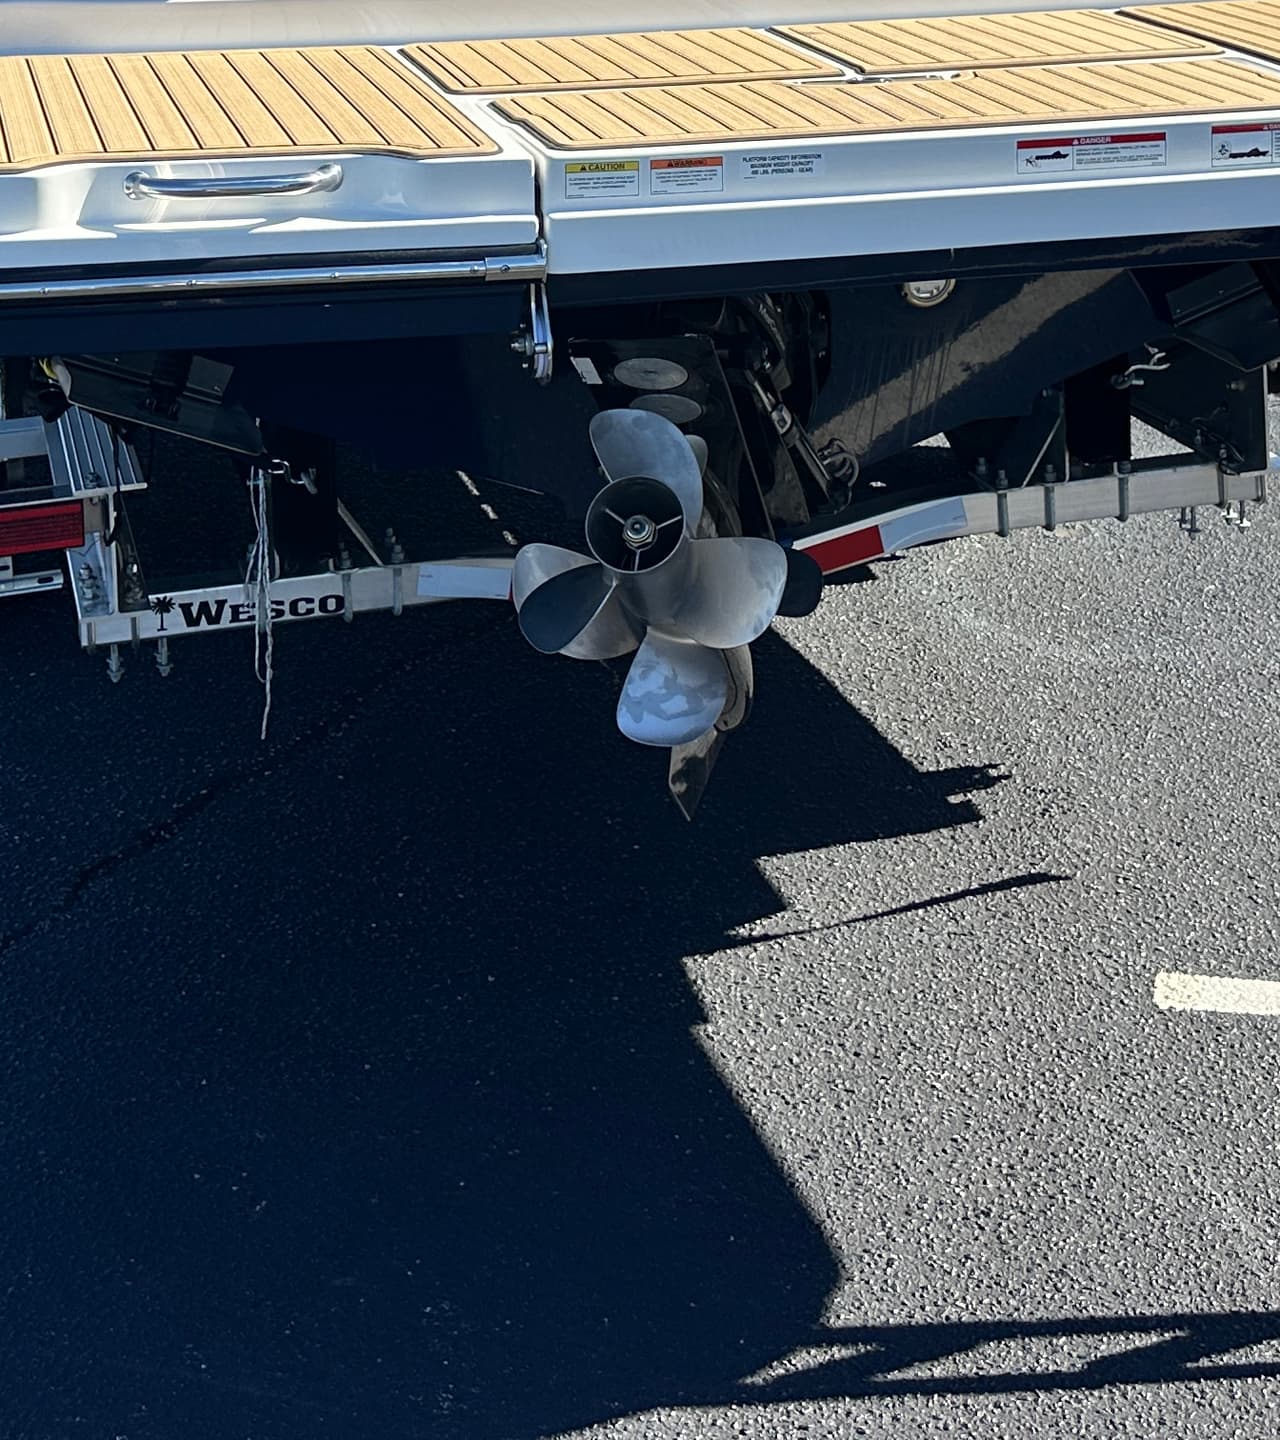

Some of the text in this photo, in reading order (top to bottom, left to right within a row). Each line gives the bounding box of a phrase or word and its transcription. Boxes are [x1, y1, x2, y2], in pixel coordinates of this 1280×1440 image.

[1079, 136, 1112, 145] DANGER
[588, 162, 626, 171] CAUTION
[178, 593, 346, 628] WESCO
